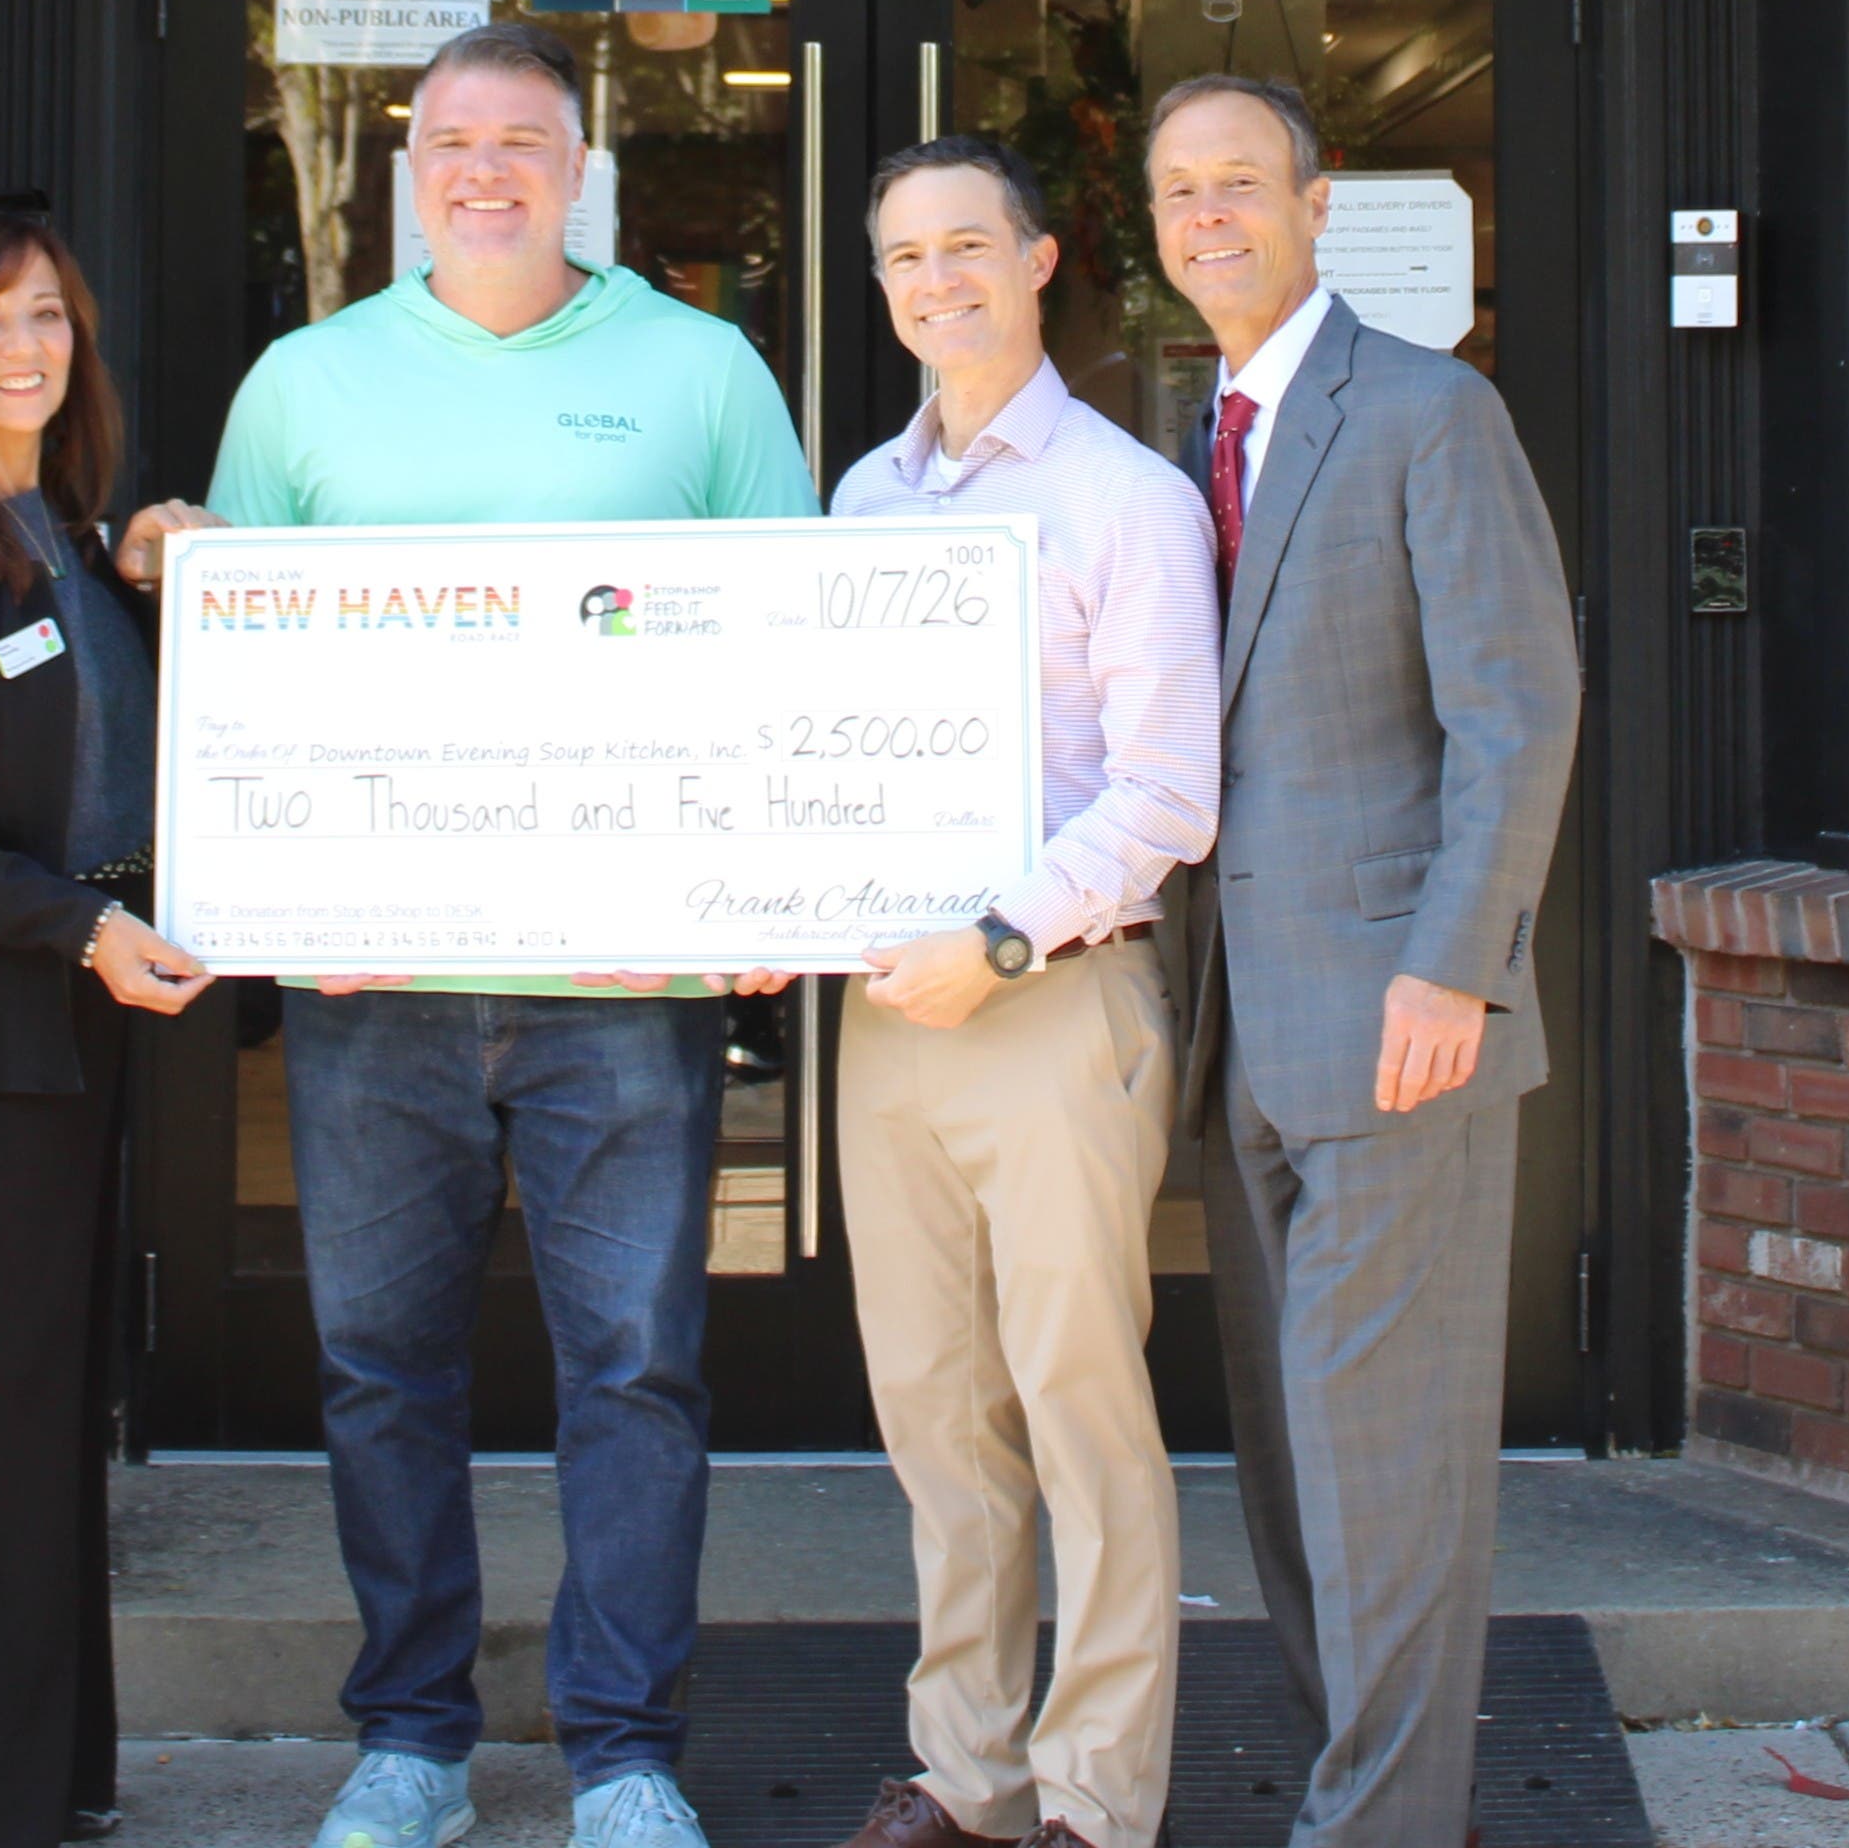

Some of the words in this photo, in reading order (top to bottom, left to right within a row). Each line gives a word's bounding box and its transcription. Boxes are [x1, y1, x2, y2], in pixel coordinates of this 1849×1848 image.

[282, 8, 421, 27] NON-PUBLIC
[424, 10, 481, 28] AREA
[1338, 201, 1353, 211] ALL
[1358, 201, 1407, 211] DELIVERY
[1408, 200, 1453, 210] DRIVERS
[557, 413, 642, 433] GLOBAL
[594, 432, 626, 444] good
[945, 547, 994, 565] 1001
[202, 570, 260, 583] FAXON
[267, 568, 304, 582] LAW
[817, 565, 990, 630] 10/7/26
[201, 589, 316, 630] NEW
[337, 586, 520, 629] HAVEN
[645, 602, 687, 617] FEED
[690, 602, 700, 617] IT
[644, 620, 722, 636] FORWARD
[757, 724, 774, 750] $
[790, 714, 990, 763] 2,500.00
[309, 744, 432, 763] Downtown
[441, 742, 531, 766] Evening
[539, 742, 595, 766] Soup
[604, 742, 700, 764] Kitchen,
[708, 742, 748, 760] Inc.
[207, 776, 312, 832] Two
[352, 773, 539, 833] Thousand
[571, 783, 635, 831] and
[678, 775, 735, 831] Five
[766, 774, 887, 829] Hundred
[685, 879, 806, 922] Frank
[229, 903, 293, 918] Donation
[296, 903, 330, 918] from
[332, 903, 369, 921] Stop
[386, 903, 422, 921] Shop
[444, 903, 483, 918] DESK
[757, 925, 847, 942] Authorized
